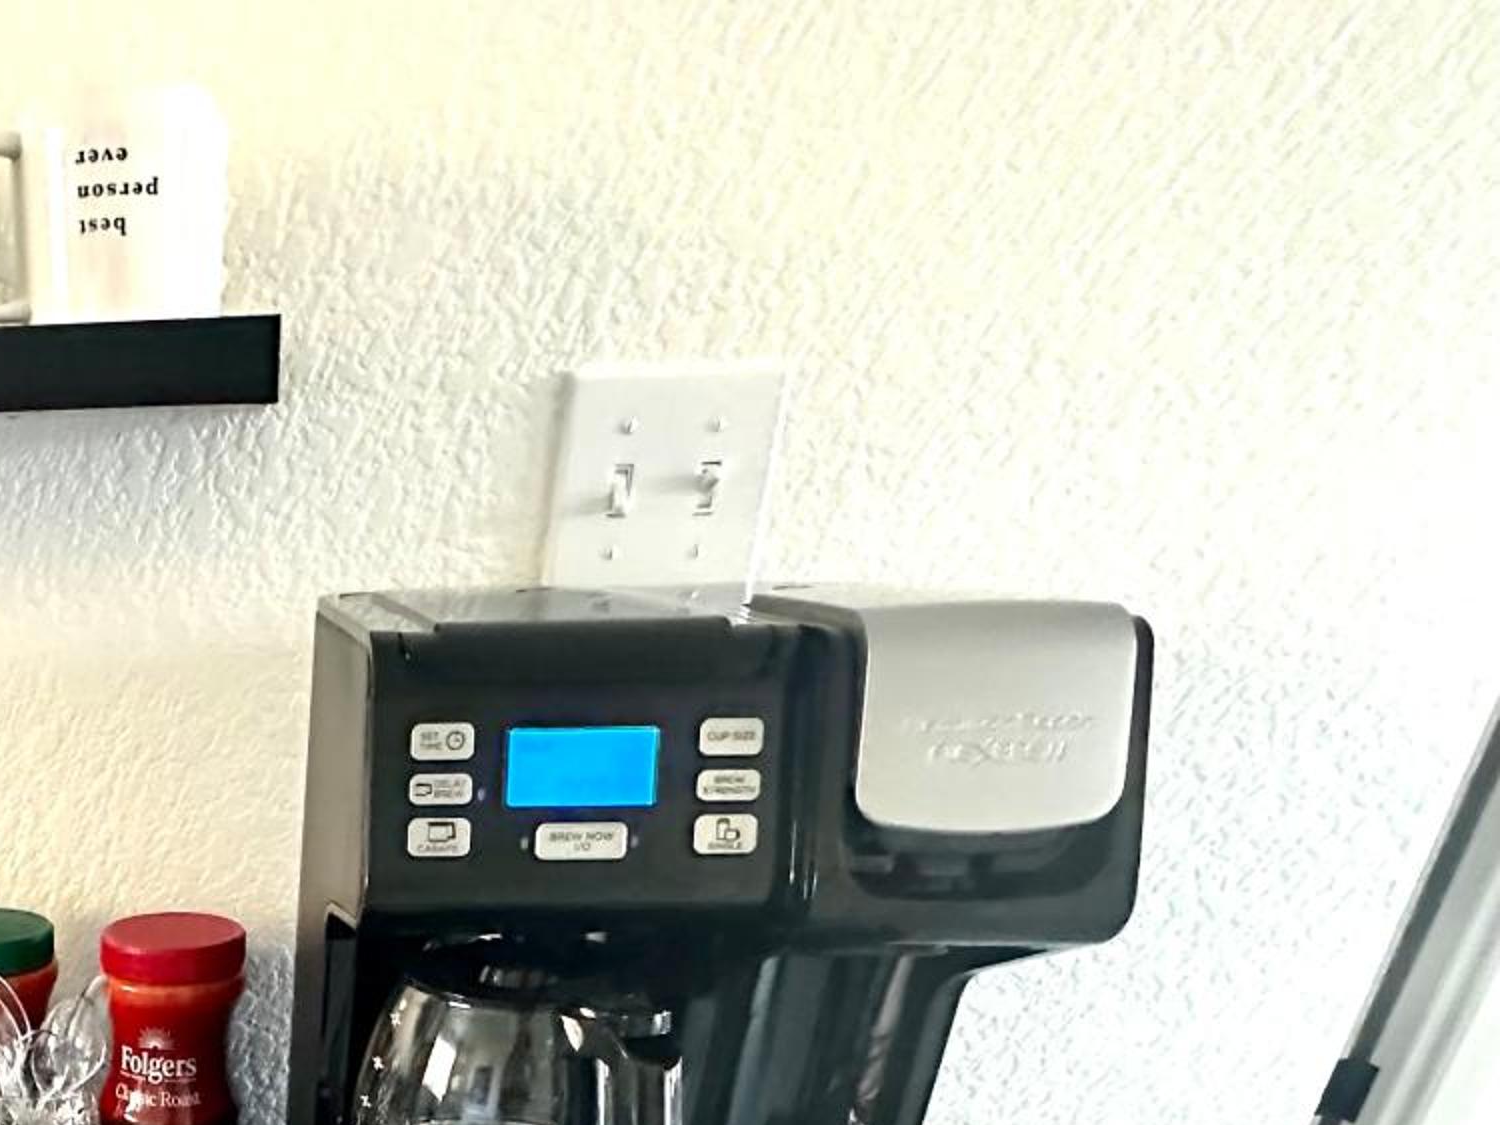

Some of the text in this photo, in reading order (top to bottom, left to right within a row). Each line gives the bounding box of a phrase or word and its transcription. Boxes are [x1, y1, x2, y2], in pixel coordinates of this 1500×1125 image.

[75, 147, 129, 165] ever
[77, 176, 159, 199] person
[79, 216, 127, 236] best
[121, 1045, 197, 1085] Folgers
